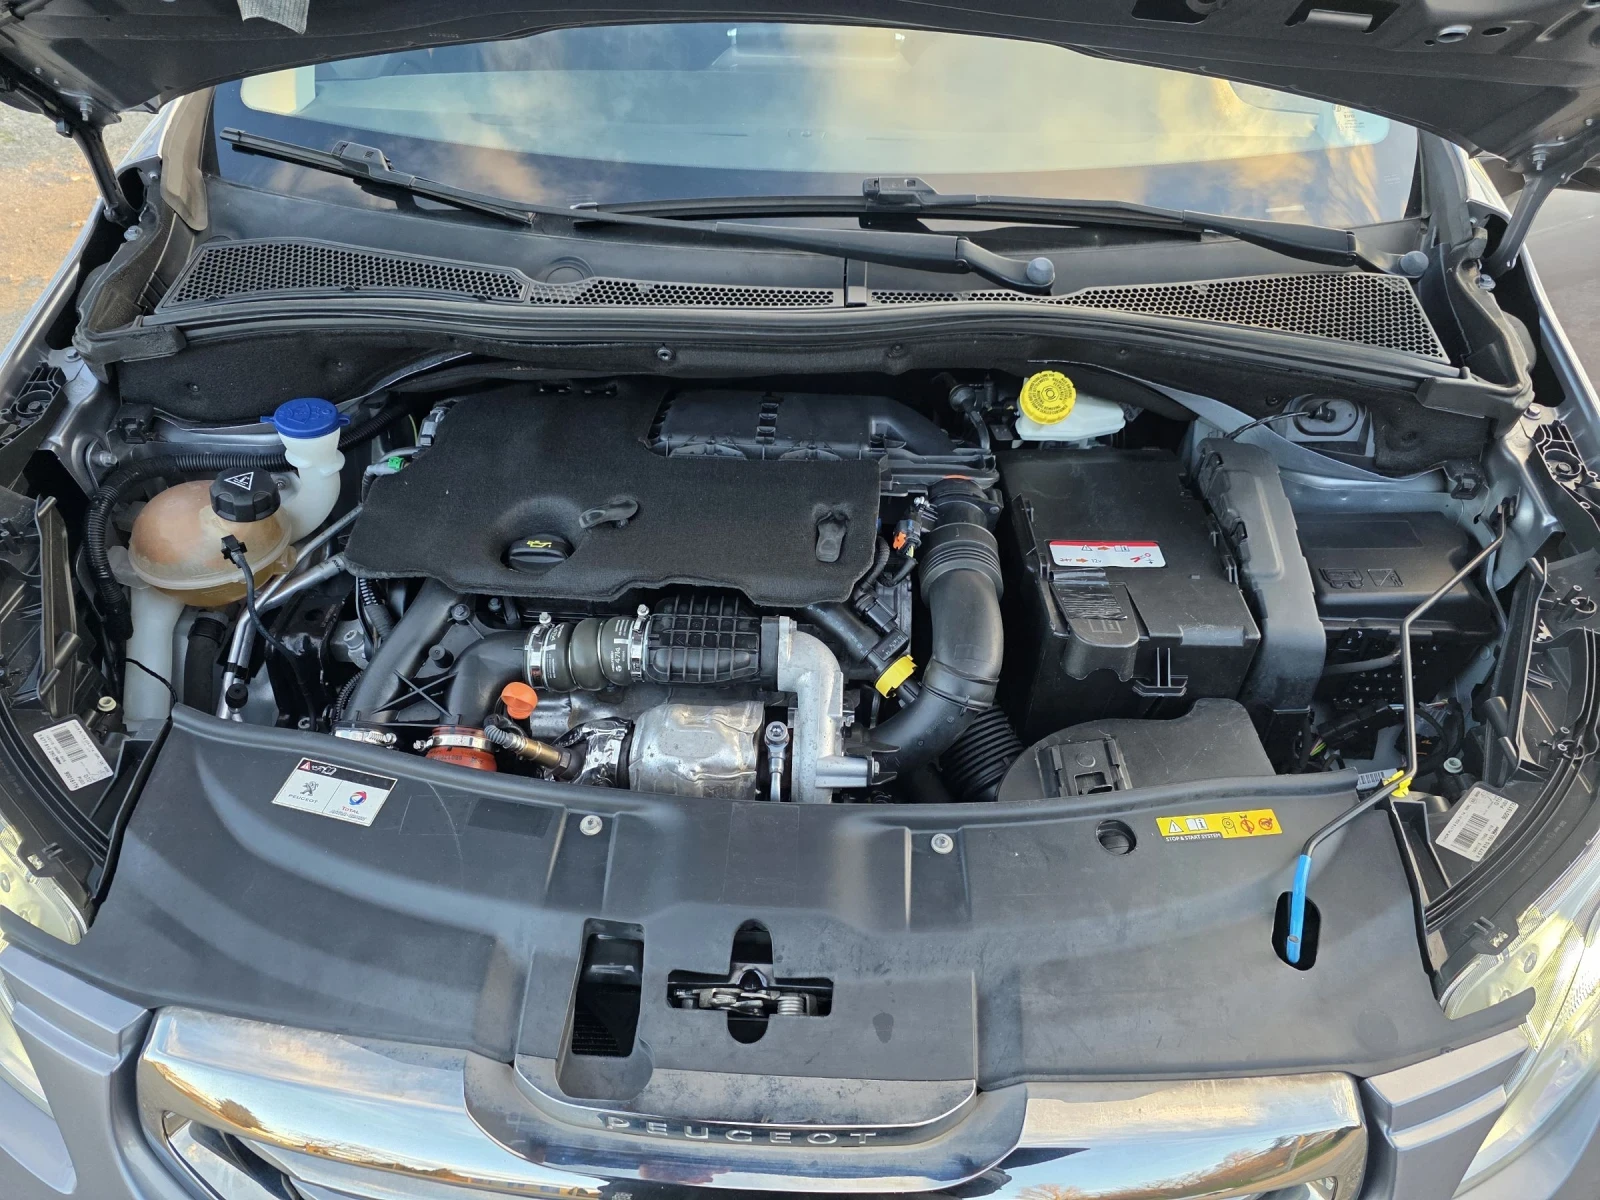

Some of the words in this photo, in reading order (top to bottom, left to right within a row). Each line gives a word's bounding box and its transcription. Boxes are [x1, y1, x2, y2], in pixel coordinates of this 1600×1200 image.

[288, 793, 319, 804] PEUGEOT
[341, 806, 360, 815] TOTAL
[598, 1114, 877, 1145] PEUGEOT
